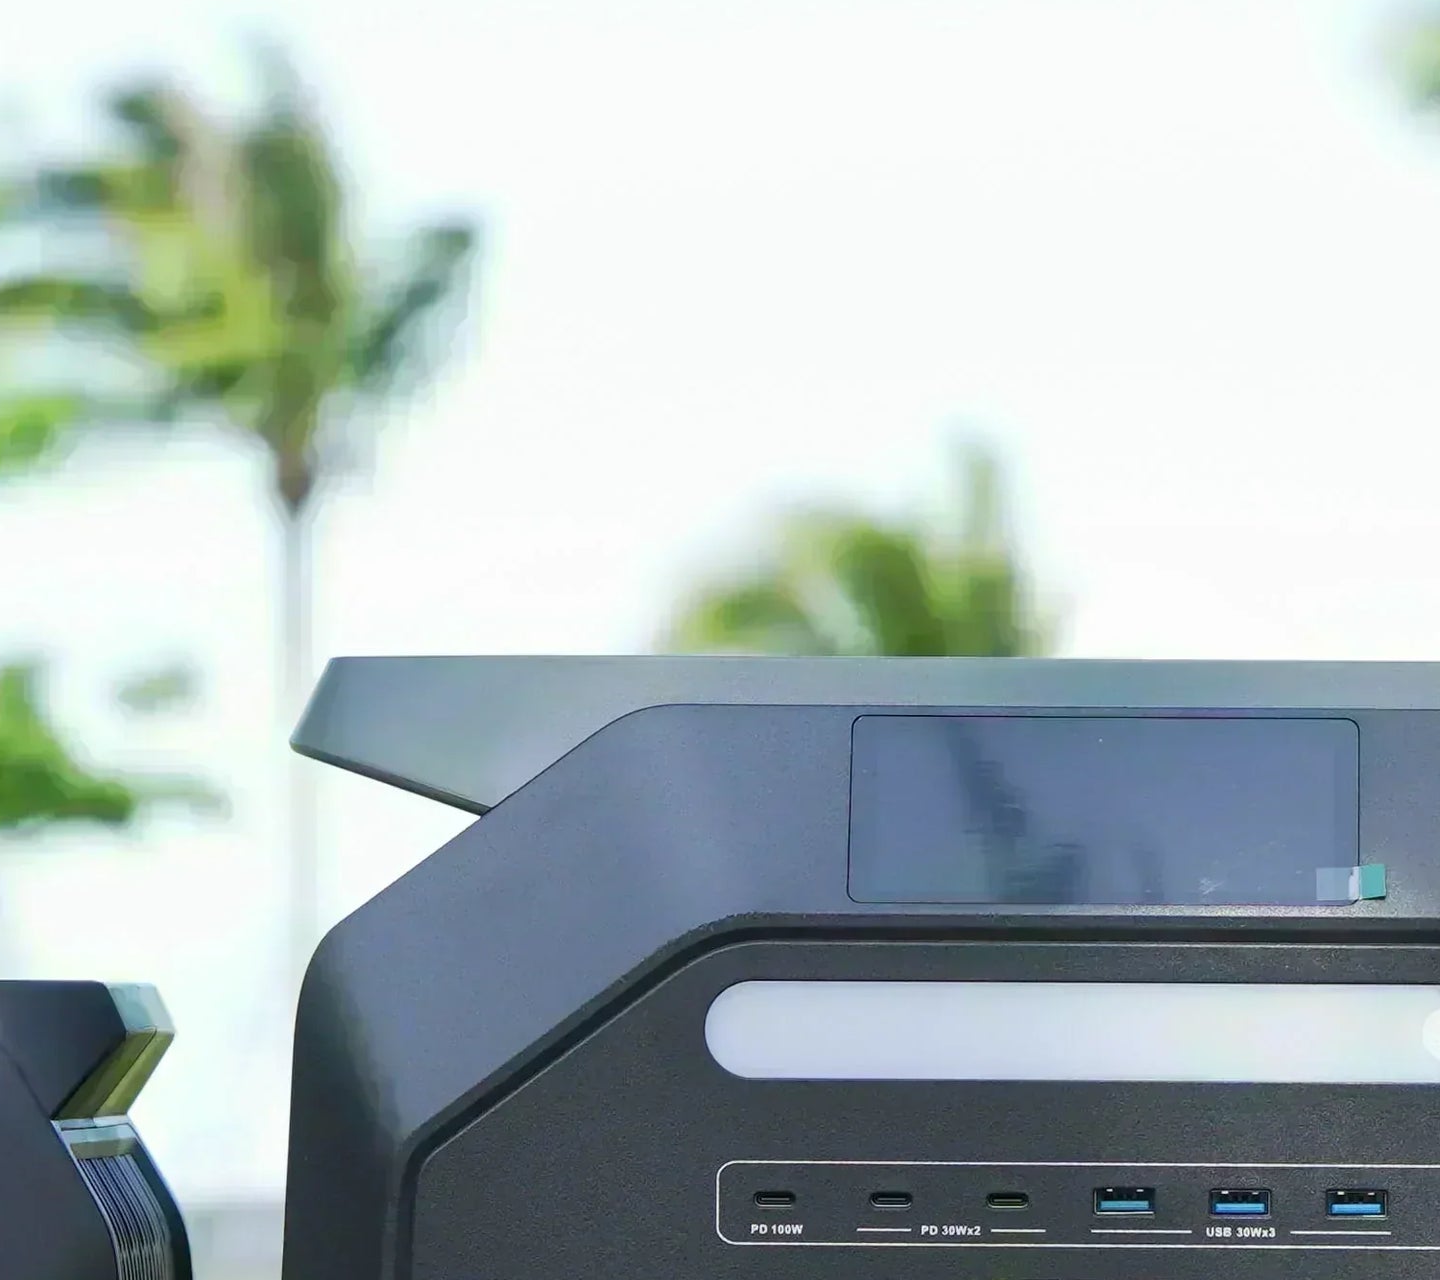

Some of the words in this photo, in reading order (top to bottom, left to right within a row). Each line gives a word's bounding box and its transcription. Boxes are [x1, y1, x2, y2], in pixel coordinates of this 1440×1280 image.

[750, 1223, 768, 1235] PD
[771, 1224, 804, 1235] 100W
[920, 1224, 939, 1236] PD
[941, 1224, 981, 1236] 30Wx2
[1205, 1226, 1233, 1238] USB
[1236, 1226, 1276, 1238] 30Wx3
